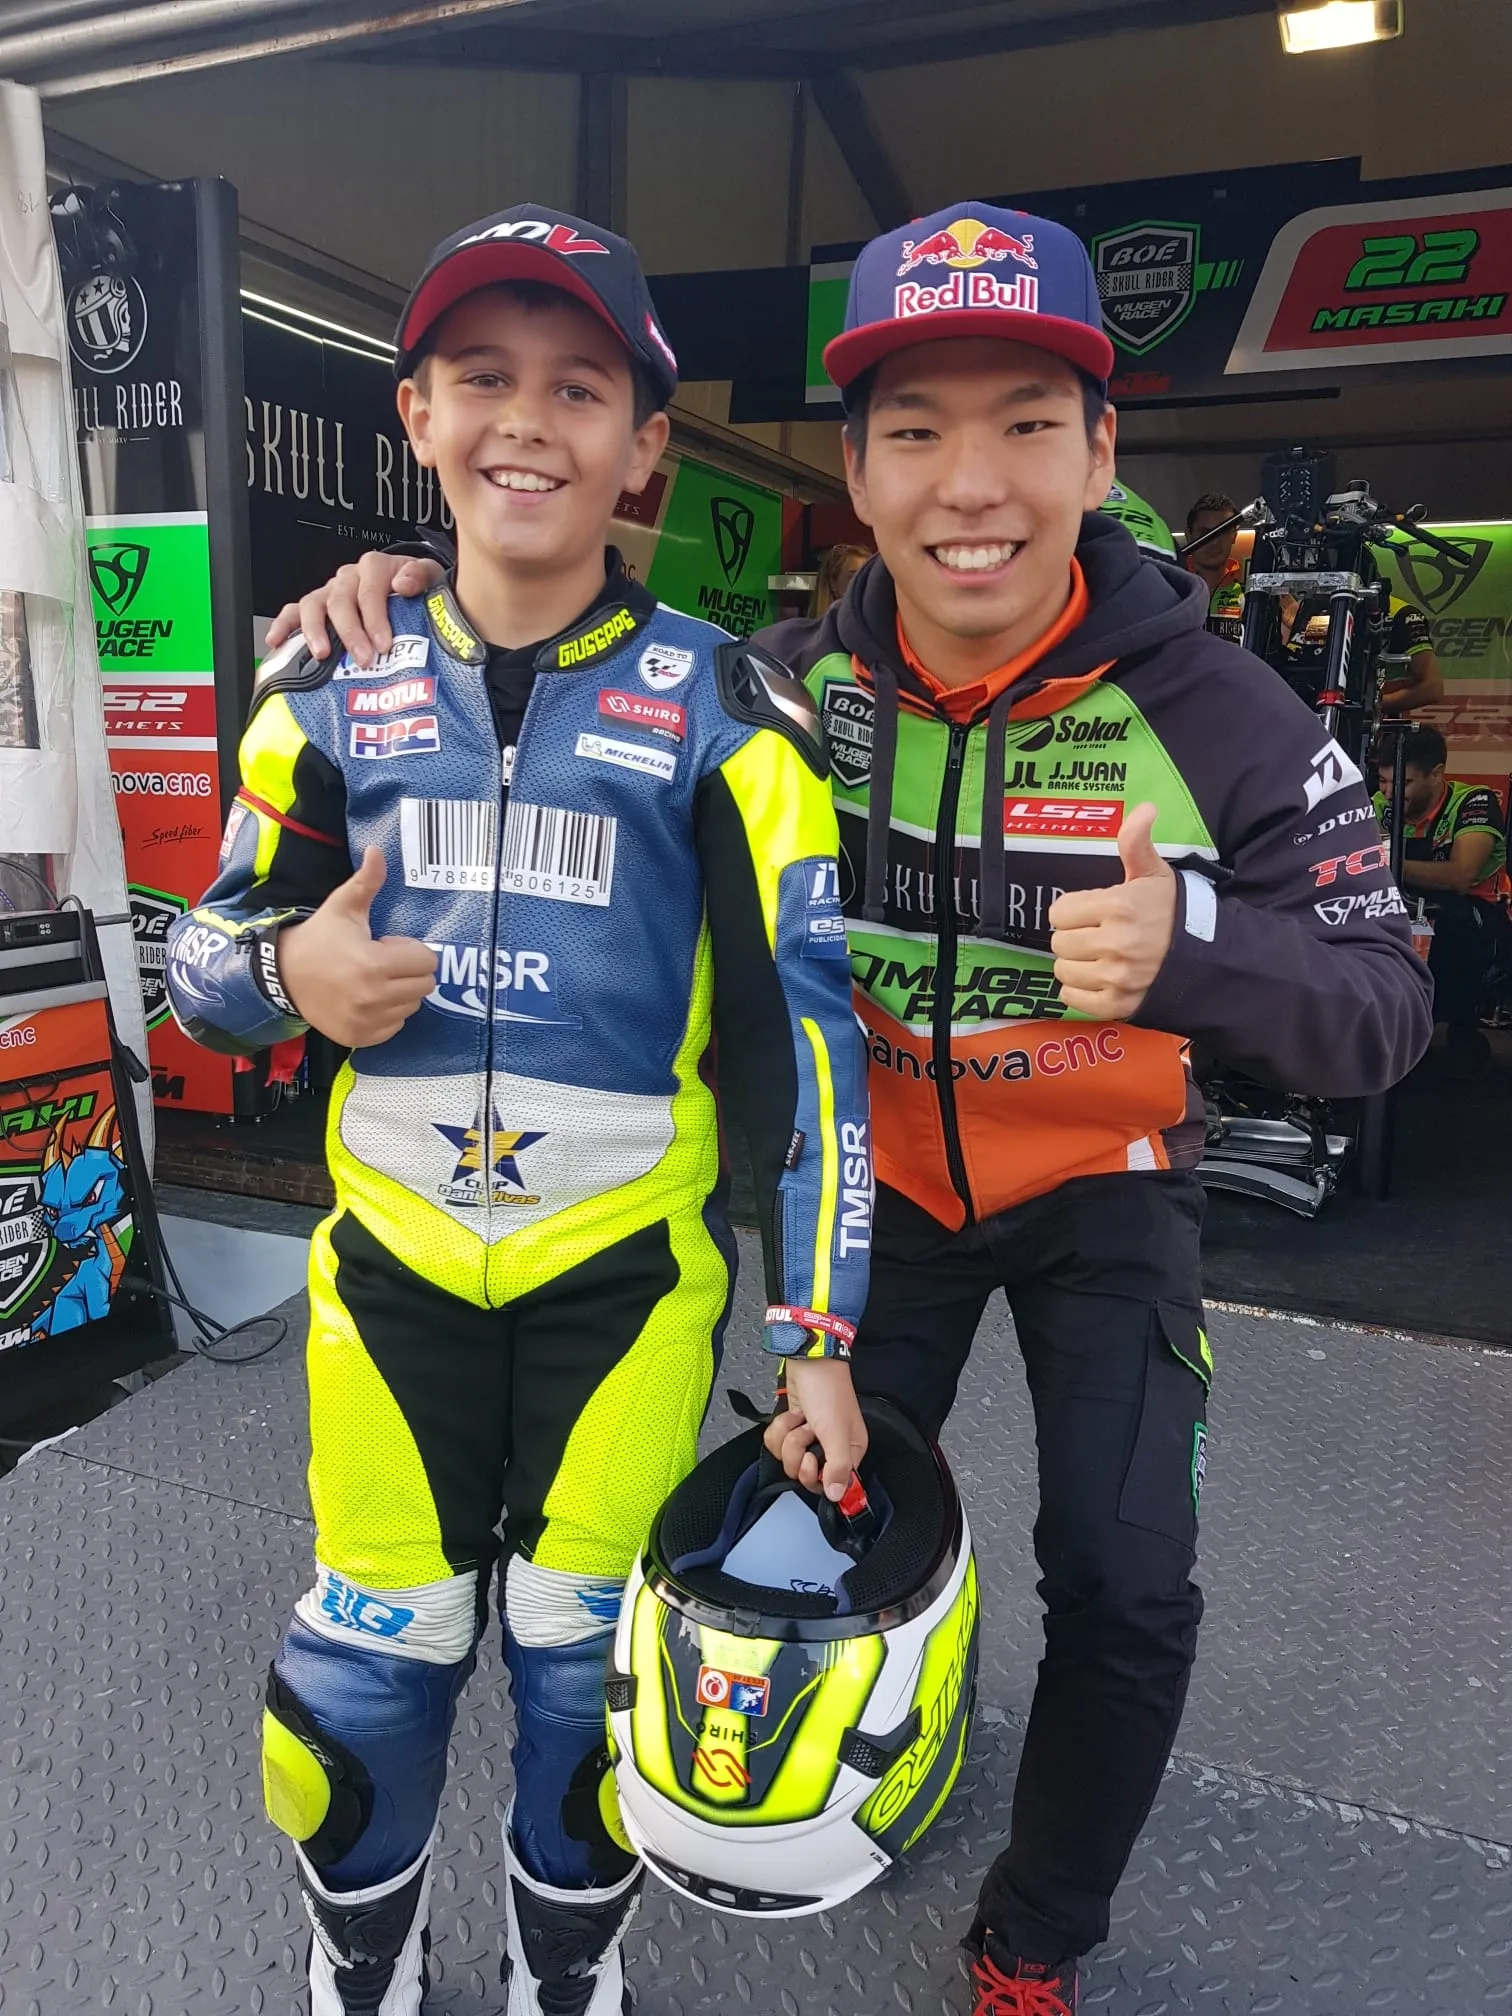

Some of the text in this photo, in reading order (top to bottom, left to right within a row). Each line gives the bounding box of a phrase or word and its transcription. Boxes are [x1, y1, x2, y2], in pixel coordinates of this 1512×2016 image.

[1345, 229, 1479, 291] 22
[1112, 270, 1174, 293] SKULL RIDER
[896, 271, 1039, 319] Red Bull
[1114, 299, 1172, 313] MUGEN
[1120, 309, 1161, 321] RACE
[1310, 294, 1508, 333] MASAKI
[116, 380, 183, 430] RIDER
[337, 525, 392, 545] EST. MMXV
[697, 585, 767, 621] MUGEN
[96, 619, 174, 638] UGEN
[97, 638, 156, 657] ACE
[352, 682, 429, 712] MOTUL
[632, 704, 681, 724] SHIRO
[652, 727, 682, 743] RACING
[833, 719, 855, 739] SKULL
[604, 748, 673, 772] MICHELIN
[835, 752, 871, 770] RACE
[1049, 761, 1127, 782] J.JUAN
[1048, 781, 1125, 792] BRAKE SYSTEMS
[1009, 803, 1117, 820] LS2
[1006, 822, 1109, 832] HELMETS
[410, 869, 419, 882] 9
[512, 874, 596, 899] 806125
[139, 945, 167, 965] RIDER
[867, 1026, 1125, 1083] anovacnc
[0, 1094, 95, 1137] AKI
[840, 1122, 871, 1258] TMSR
